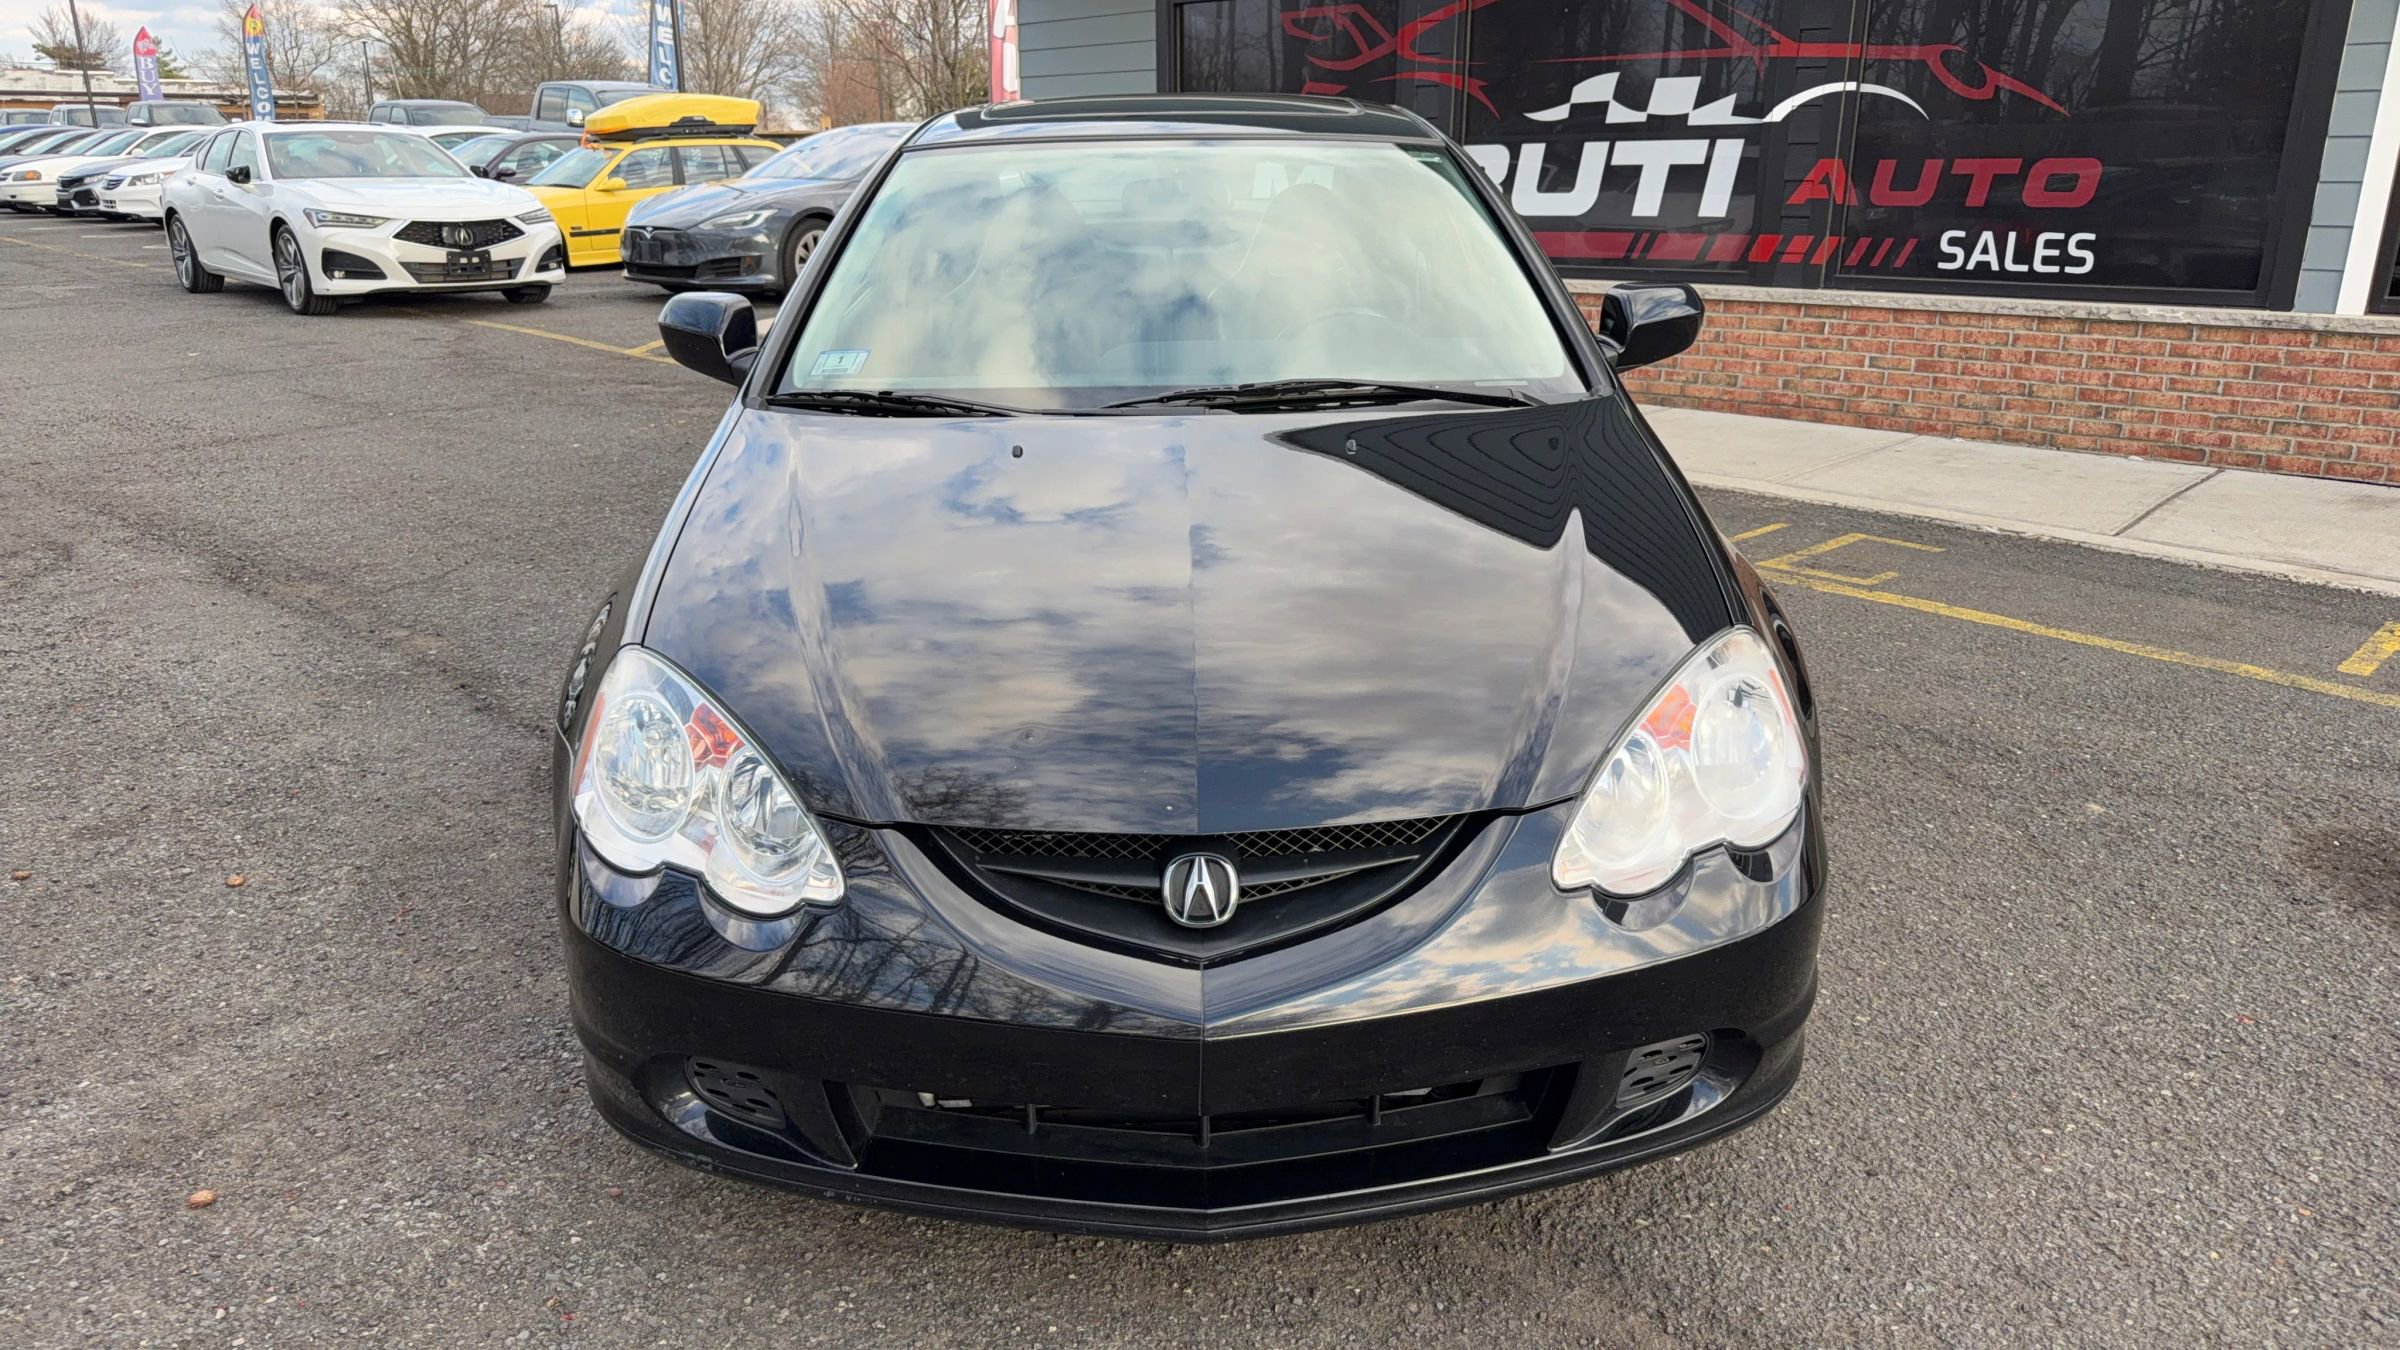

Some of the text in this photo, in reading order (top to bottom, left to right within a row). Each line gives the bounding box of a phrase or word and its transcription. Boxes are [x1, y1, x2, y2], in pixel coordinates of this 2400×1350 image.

[140, 57, 157, 95] BUY
[1786, 157, 2103, 208] AUTO
[1937, 229, 2097, 274] SALES
